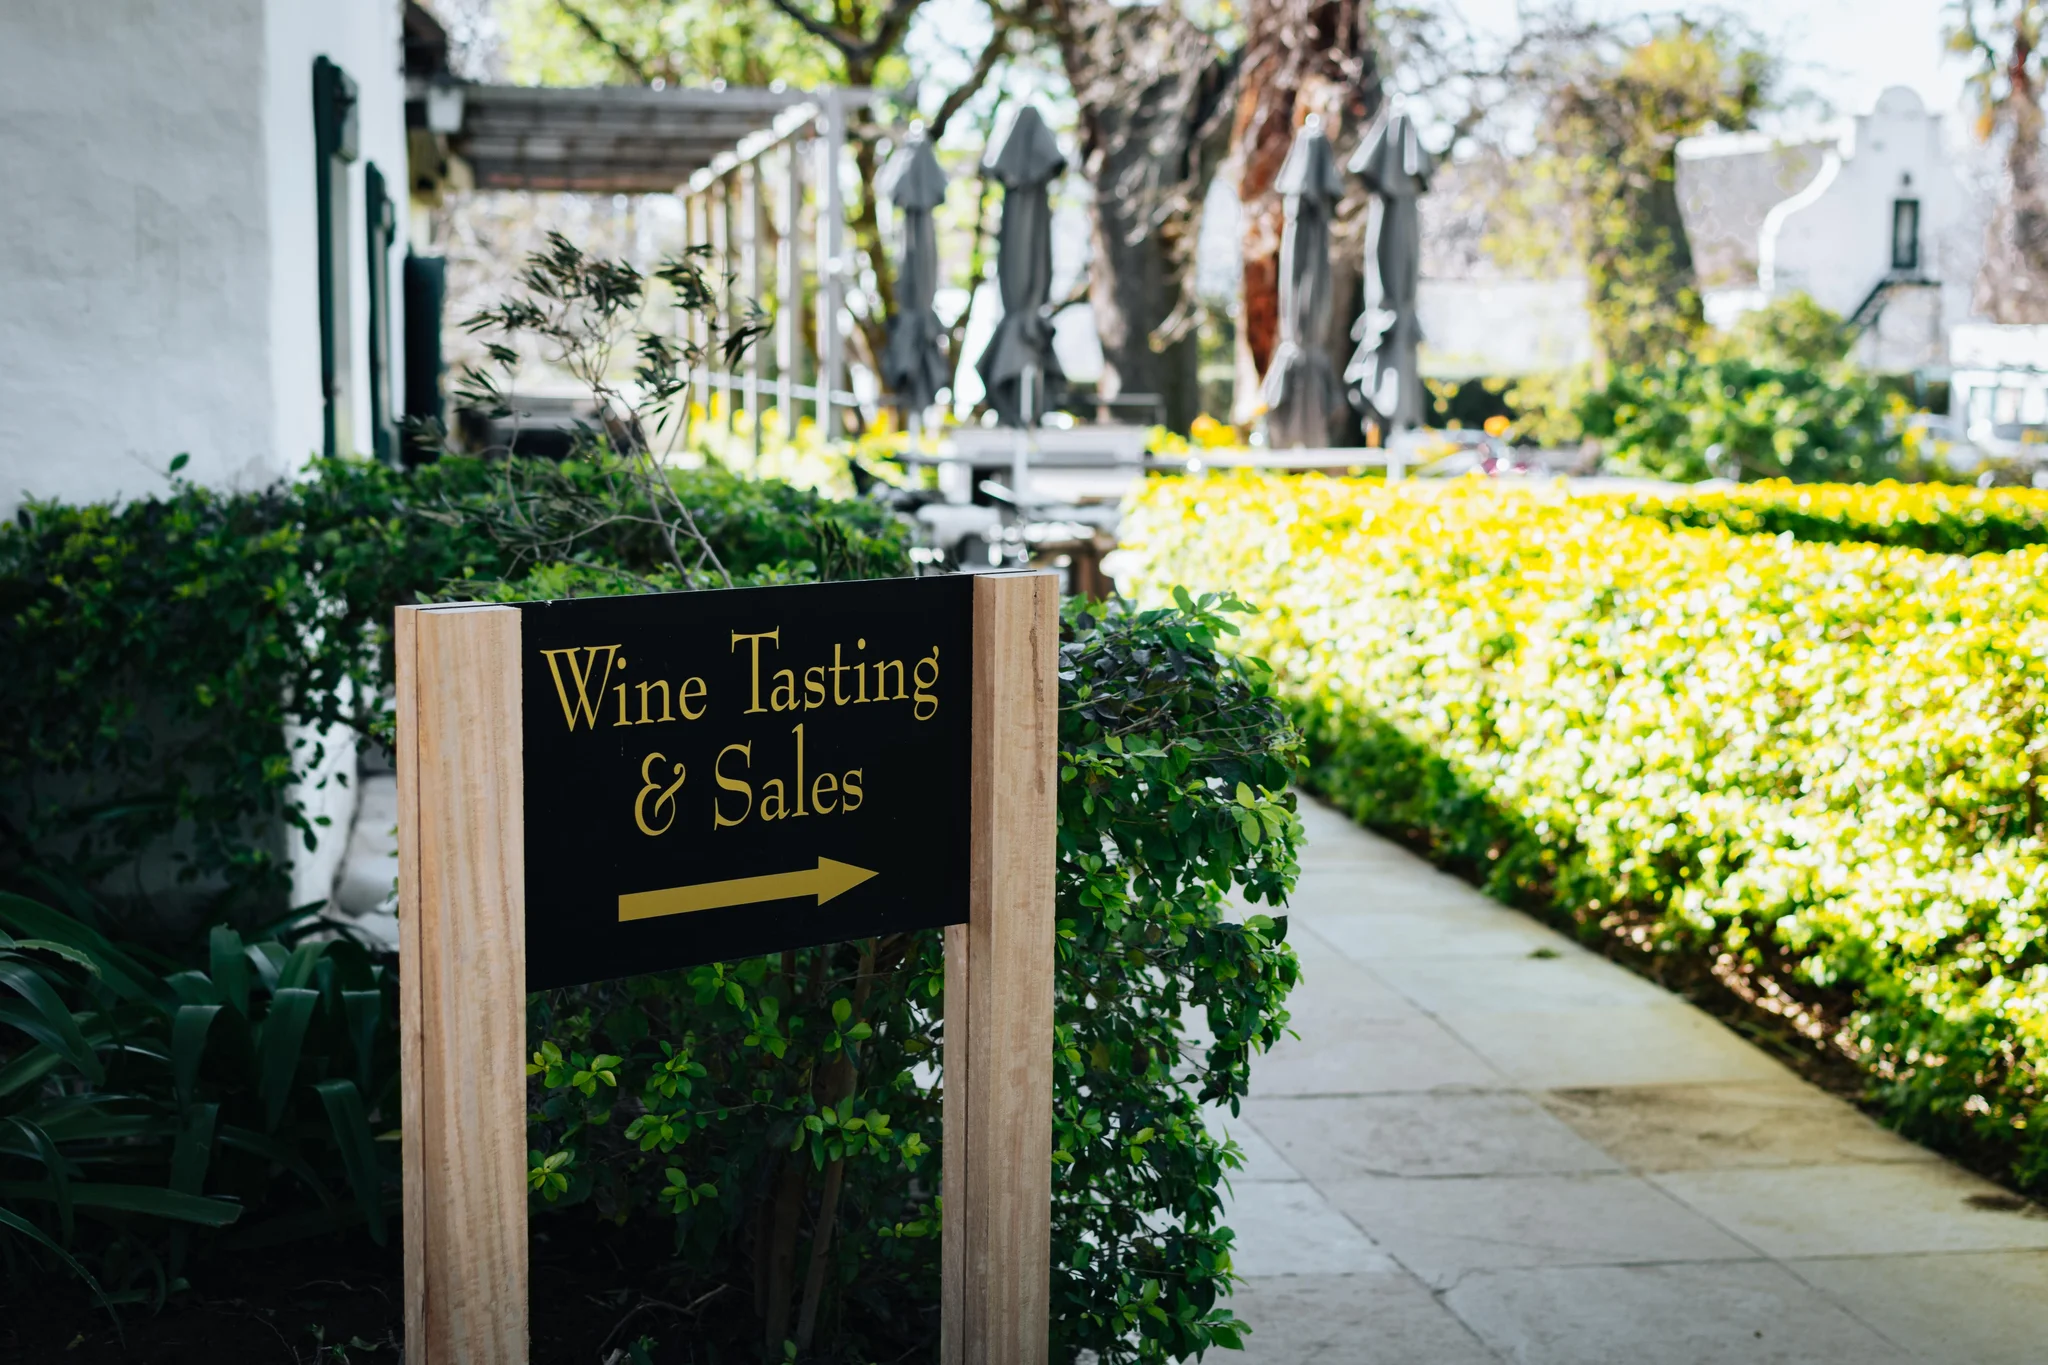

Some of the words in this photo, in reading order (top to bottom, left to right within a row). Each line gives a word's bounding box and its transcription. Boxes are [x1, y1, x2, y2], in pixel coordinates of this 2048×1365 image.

[540, 644, 707, 732] Wine
[731, 626, 939, 720] Tasting
[635, 752, 686, 836] &
[714, 723, 863, 830] Sales
